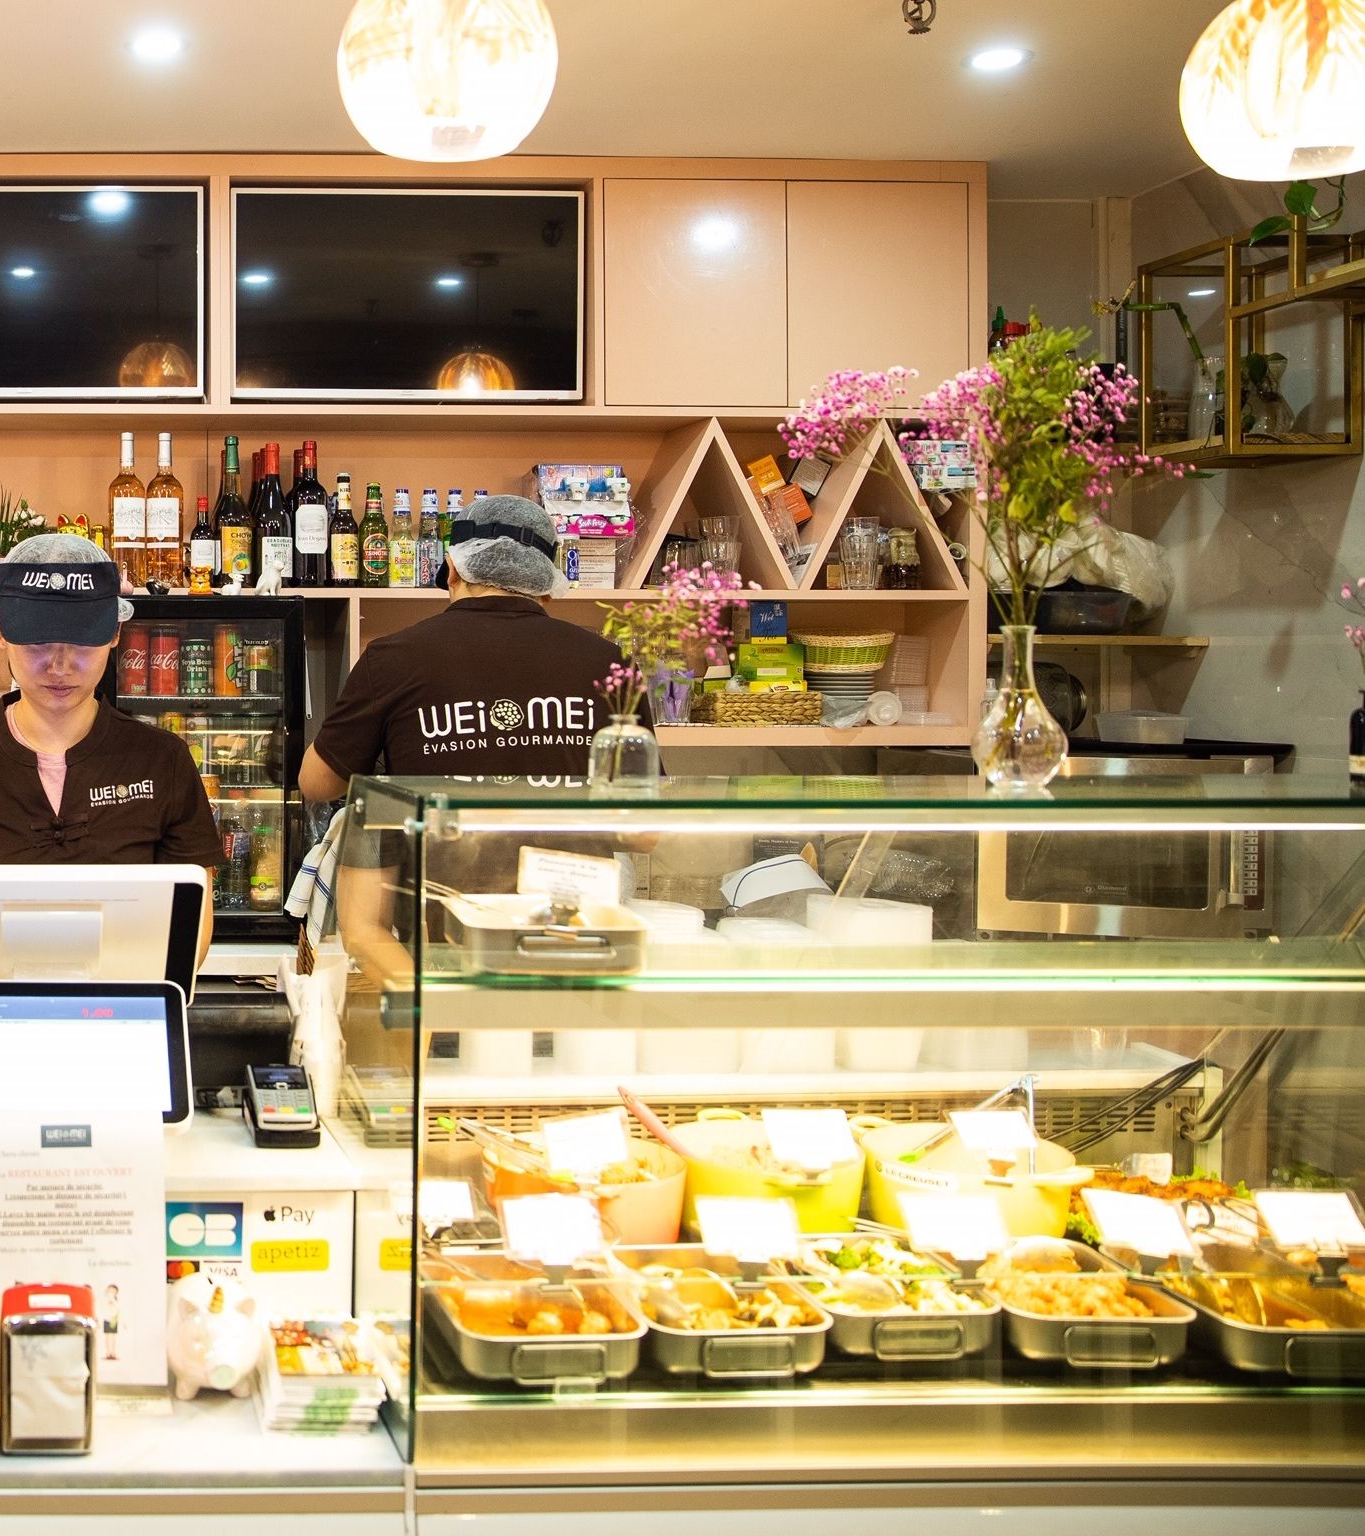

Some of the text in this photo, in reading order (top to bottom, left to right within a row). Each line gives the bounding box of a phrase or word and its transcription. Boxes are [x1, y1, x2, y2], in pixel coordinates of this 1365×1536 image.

[423, 735, 592, 755] ÉVASION GOURMANDE
[8, 1167, 133, 1179] RESTAURANT EST OUVERT
[280, 1206, 315, 1226] Pay
[258, 1241, 322, 1263] apetiz
